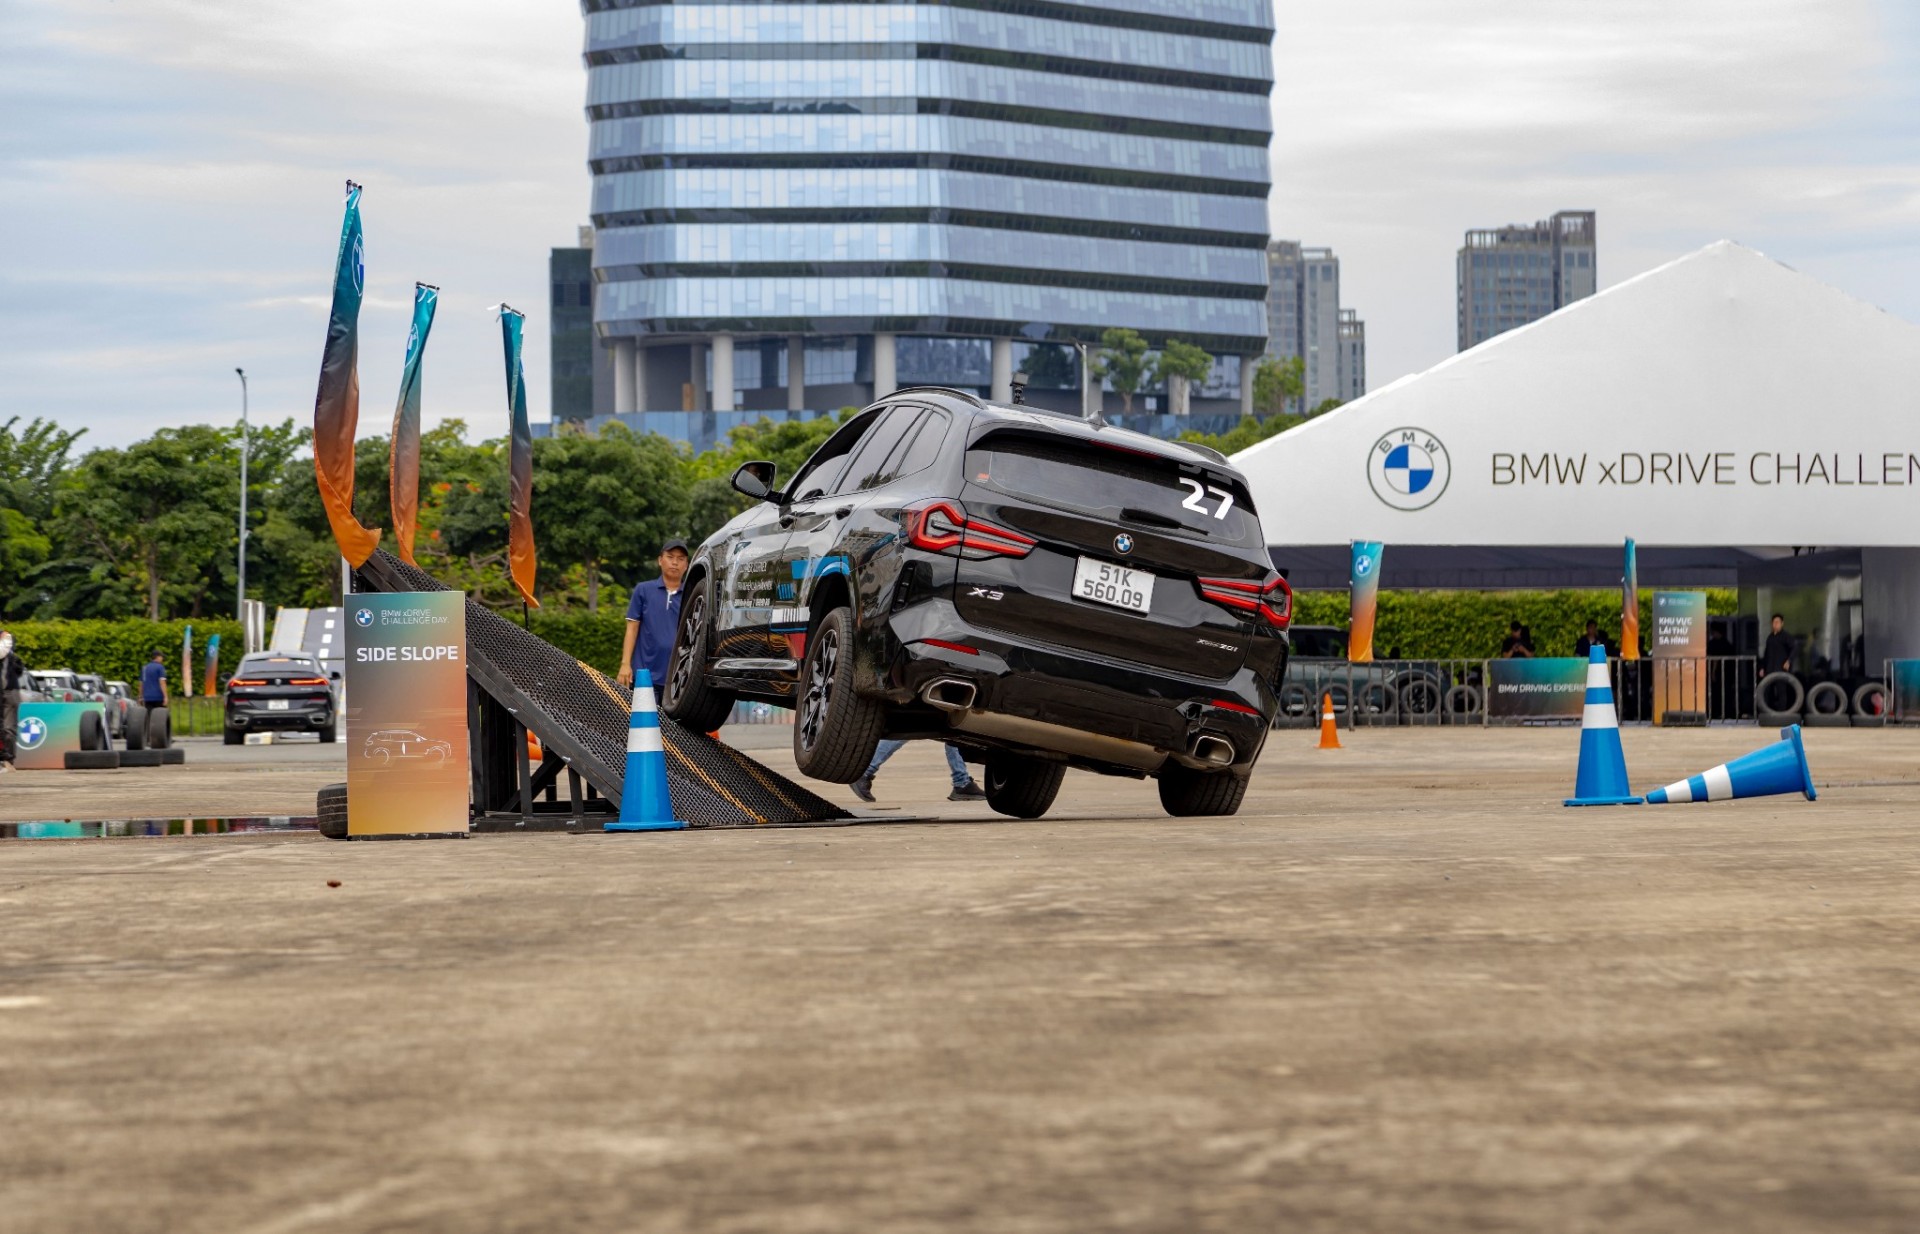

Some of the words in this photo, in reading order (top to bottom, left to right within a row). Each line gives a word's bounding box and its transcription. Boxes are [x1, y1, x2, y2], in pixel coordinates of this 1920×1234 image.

[1379, 431, 1440, 454] BMW
[1492, 452, 1587, 485] BMW
[1598, 452, 1736, 485] xDRIVE
[1178, 476, 1235, 520] 27
[1100, 564, 1133, 587] 51K
[966, 586, 1005, 601] X3
[1083, 579, 1143, 608] 560.09
[381, 609, 401, 617] BMW
[403, 608, 431, 617] xDRIVE
[381, 617, 430, 625] CHALLENGE
[1659, 617, 1675, 625] KHU
[356, 646, 397, 662] SIDE
[400, 645, 459, 661] SLOPE
[1498, 683, 1519, 694] BMW
[1519, 683, 1552, 693] DRIVING
